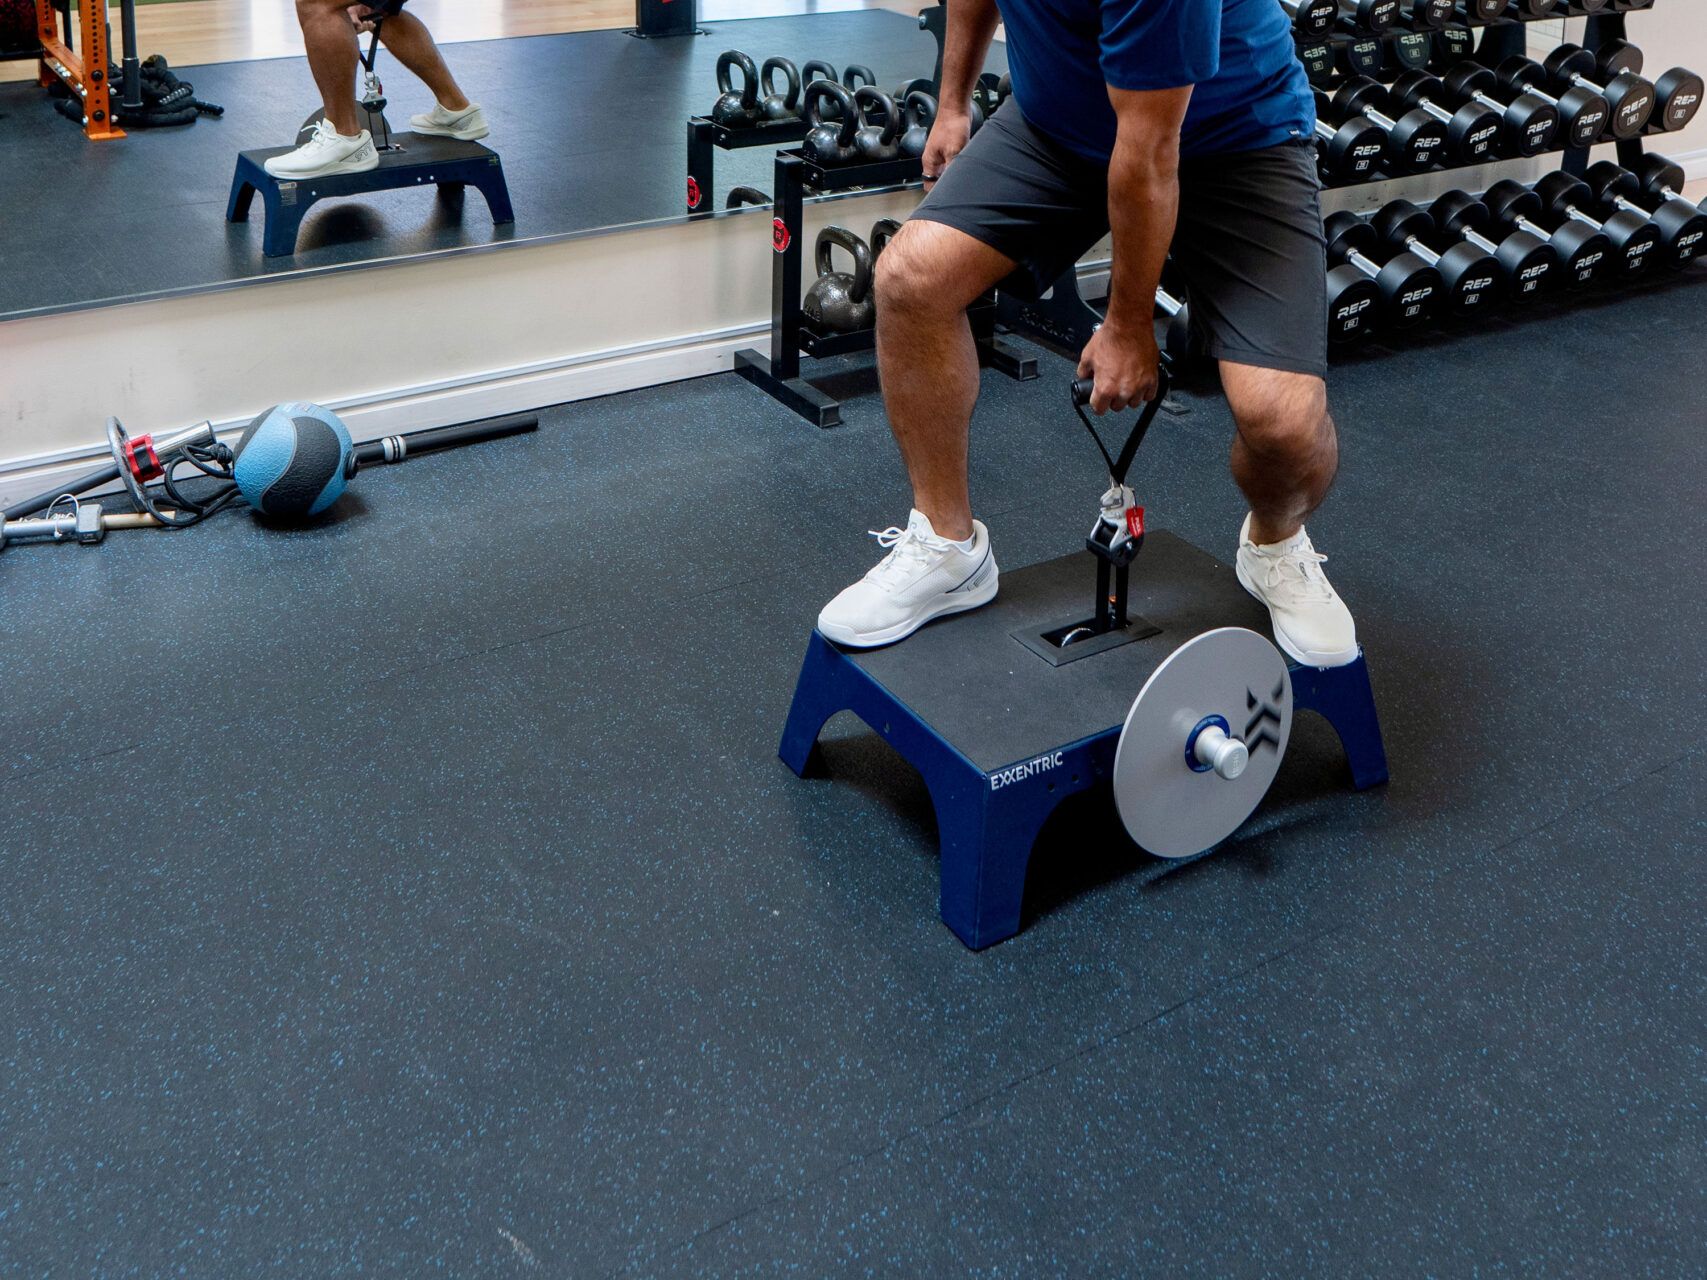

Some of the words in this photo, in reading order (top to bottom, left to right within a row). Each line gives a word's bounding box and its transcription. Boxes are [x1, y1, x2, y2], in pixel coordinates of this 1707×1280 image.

[1311, 6, 1333, 18] REP
[1374, 1, 1396, 16] REP
[1621, 96, 1648, 117] REP
[1673, 94, 1697, 106] REP
[1578, 111, 1603, 126] REP
[1469, 125, 1497, 144] REP
[1526, 119, 1553, 136] REP
[1353, 144, 1381, 157] REP
[1414, 137, 1441, 148] REP
[1677, 231, 1704, 248] REP
[1626, 240, 1654, 258] REP
[1575, 251, 1603, 270] REP
[1520, 263, 1549, 280] REP
[1462, 277, 1493, 291] REP
[1401, 286, 1433, 304] REP
[1337, 298, 1371, 319] REP
[990, 751, 1064, 791] EXXENTRIC
